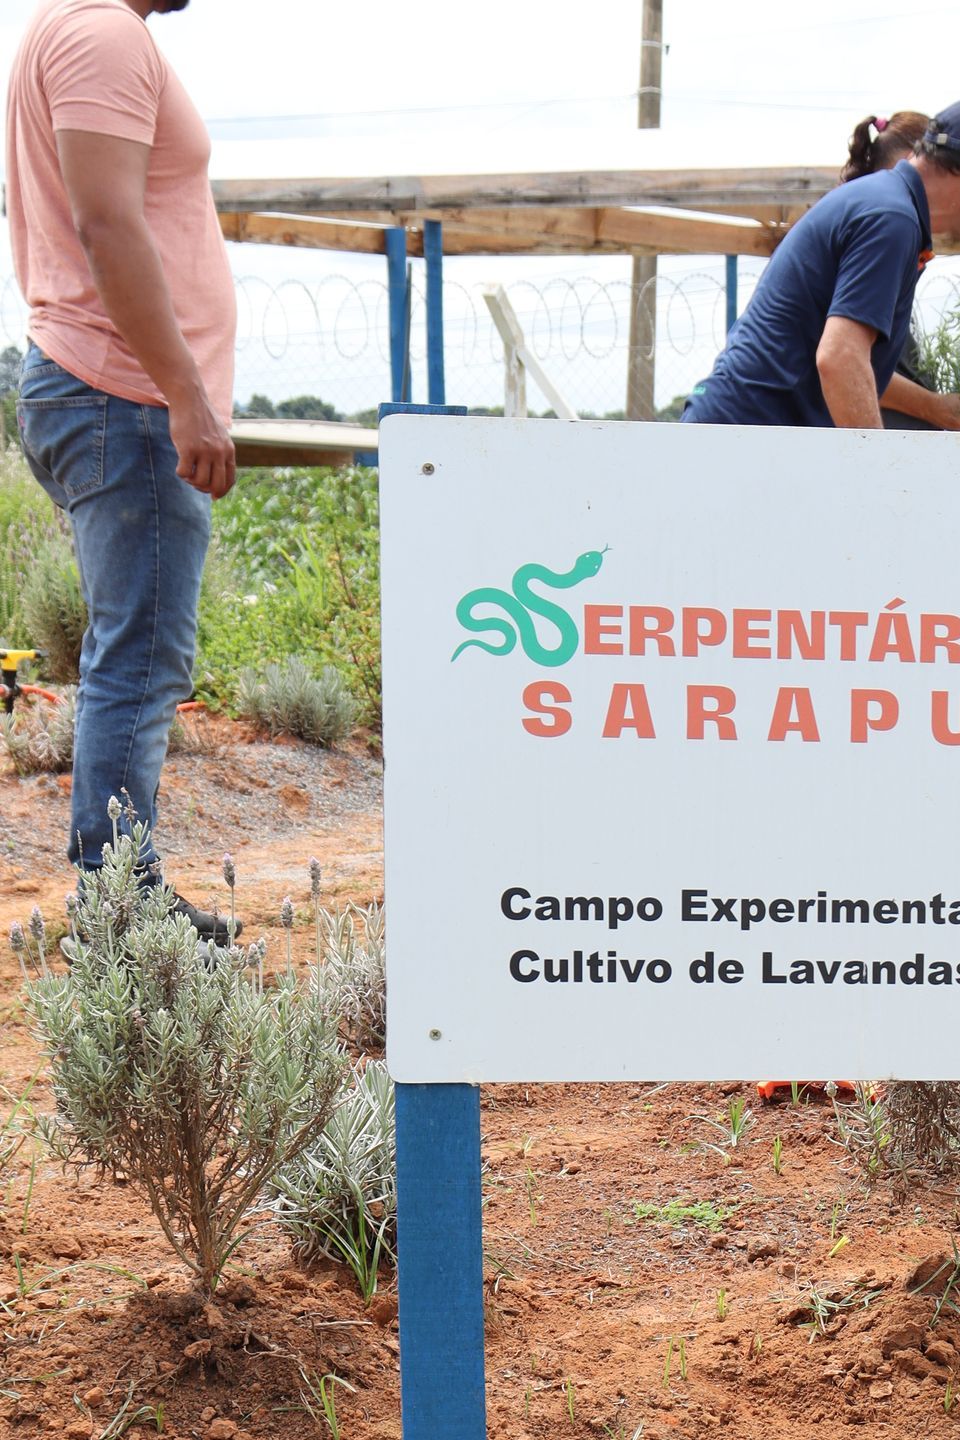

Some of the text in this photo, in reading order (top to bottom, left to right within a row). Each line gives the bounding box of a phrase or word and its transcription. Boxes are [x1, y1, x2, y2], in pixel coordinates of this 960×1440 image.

[500, 887, 663, 931] Campo
[509, 949, 672, 984] Cultivo
[689, 951, 744, 984] de
